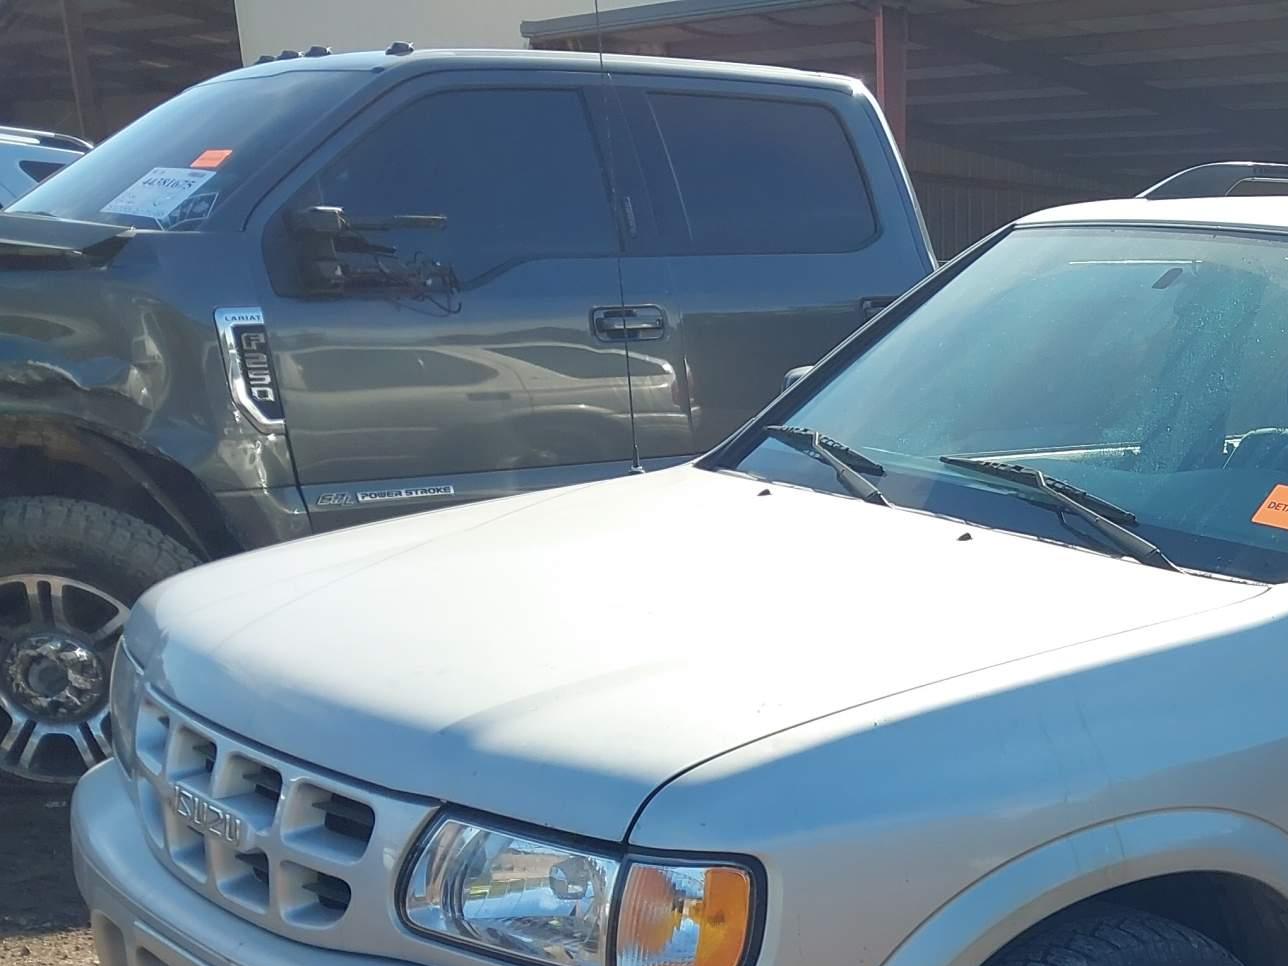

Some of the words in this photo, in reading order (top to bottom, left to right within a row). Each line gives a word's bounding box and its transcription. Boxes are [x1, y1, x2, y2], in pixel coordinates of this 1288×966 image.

[224, 314, 262, 322] LARIAT
[359, 490, 402, 500] POWER
[405, 485, 452, 496] STROKE
[174, 785, 242, 847] ISUZU
